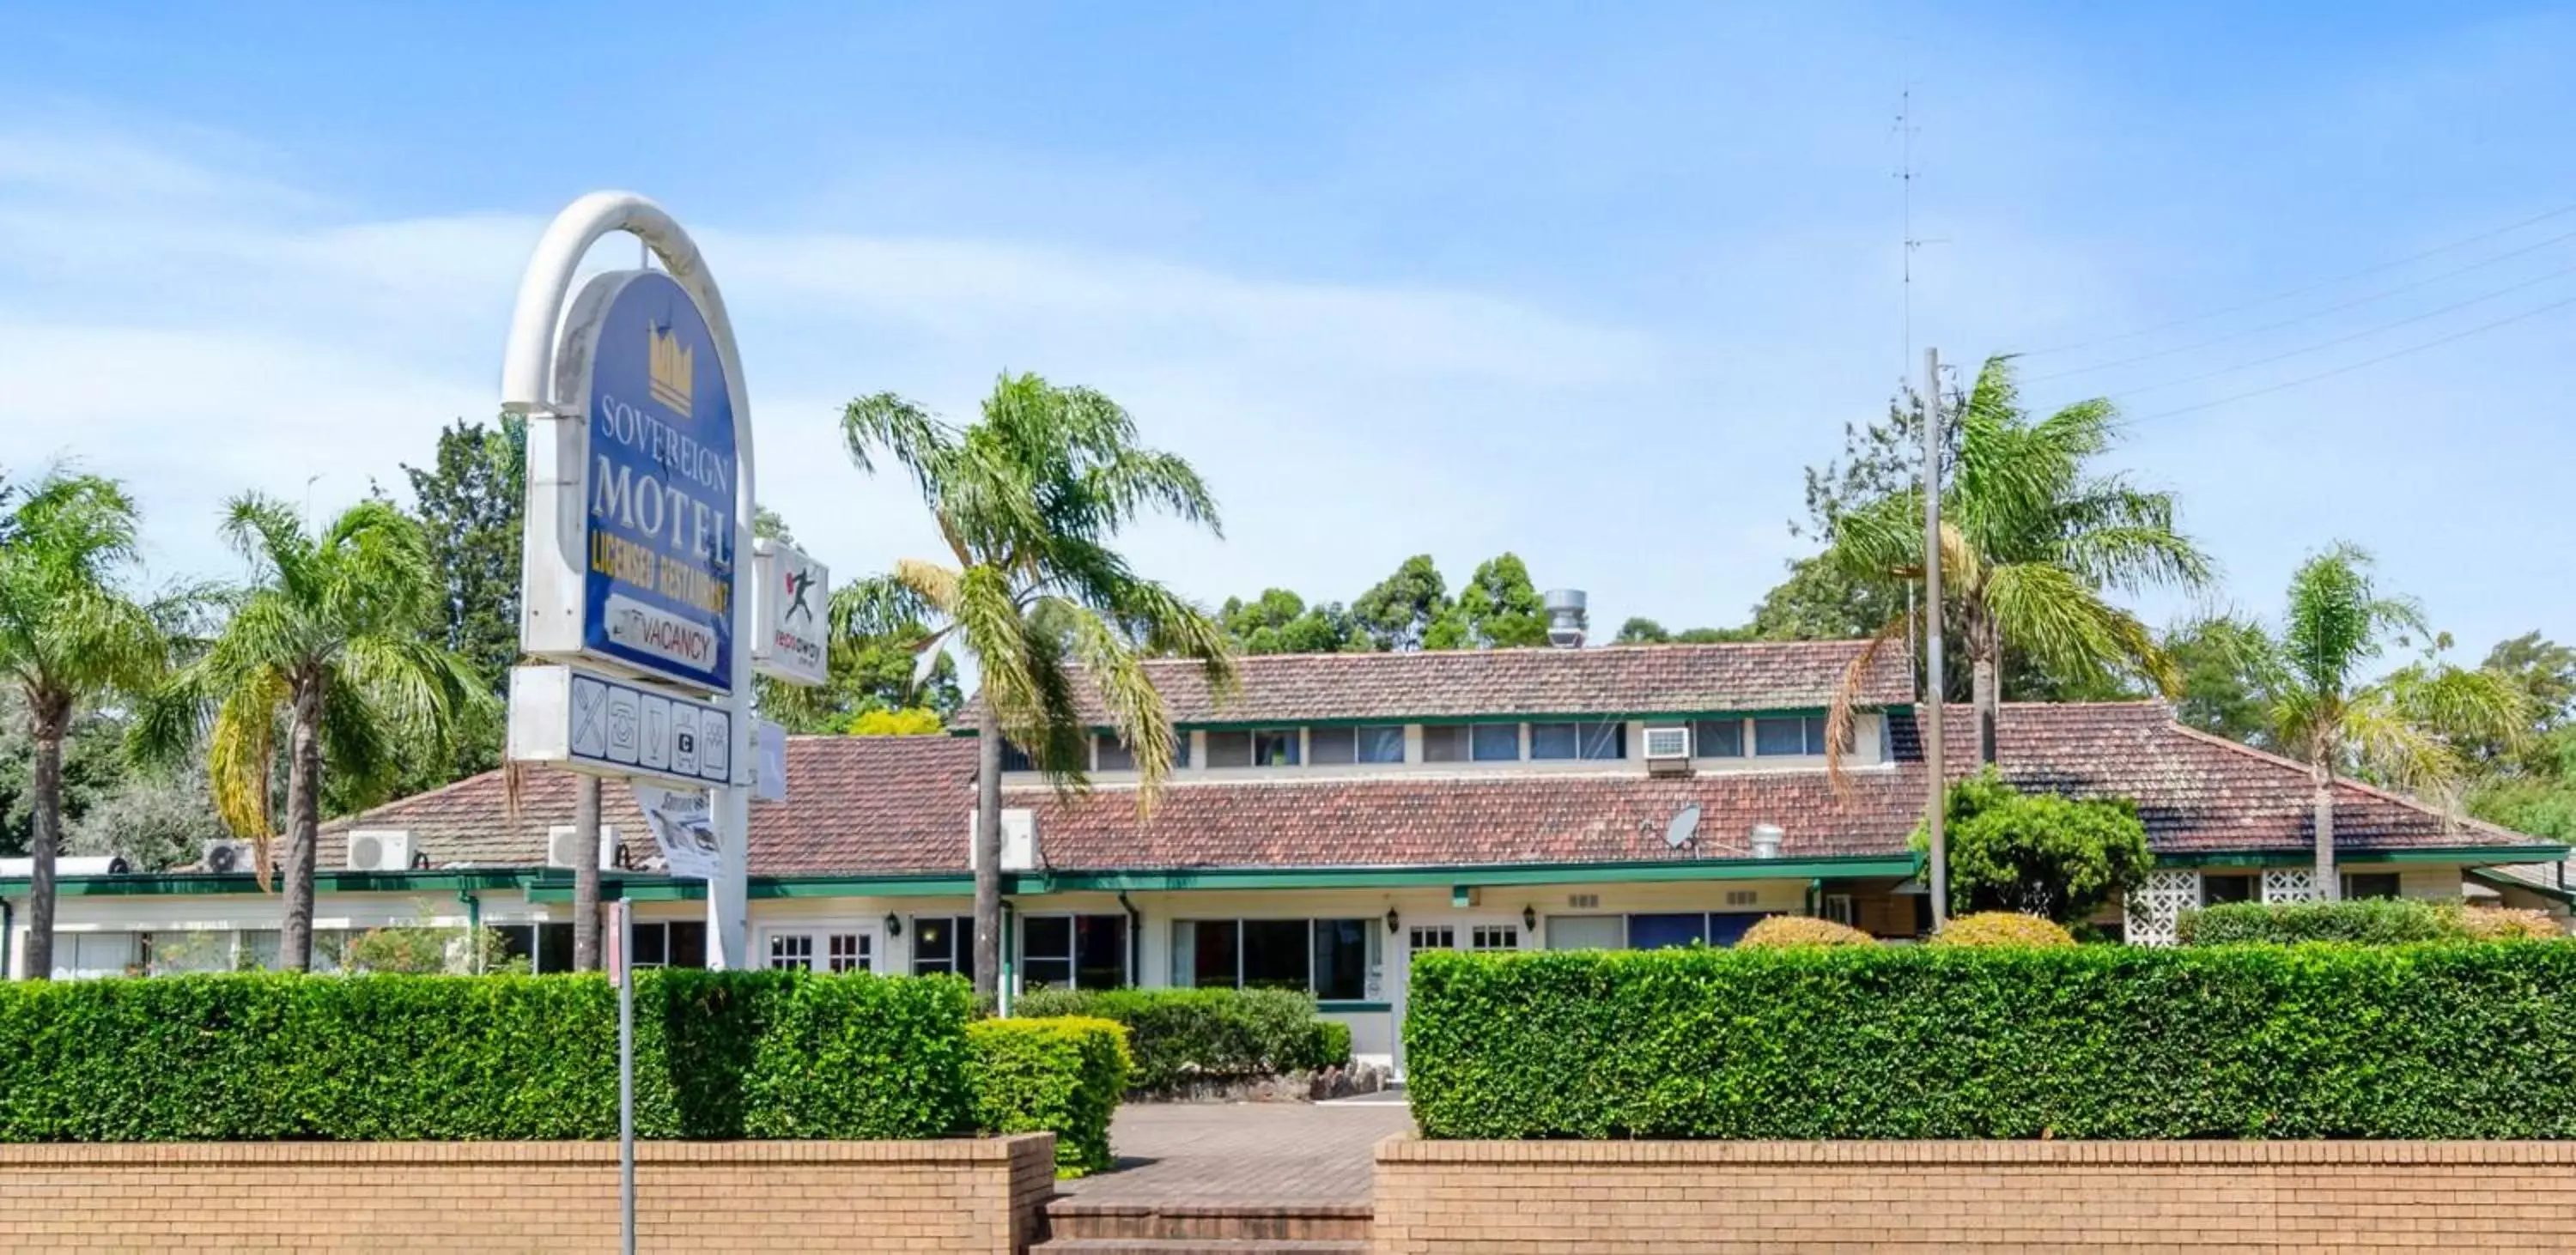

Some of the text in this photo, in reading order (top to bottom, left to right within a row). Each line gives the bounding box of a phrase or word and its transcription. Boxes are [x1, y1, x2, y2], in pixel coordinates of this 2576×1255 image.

[602, 395, 729, 494] SOVEREIGN
[591, 452, 729, 565] MOTEL
[592, 529, 728, 615] LICENSED RESTAURANT
[644, 616, 710, 662] VACANCY
